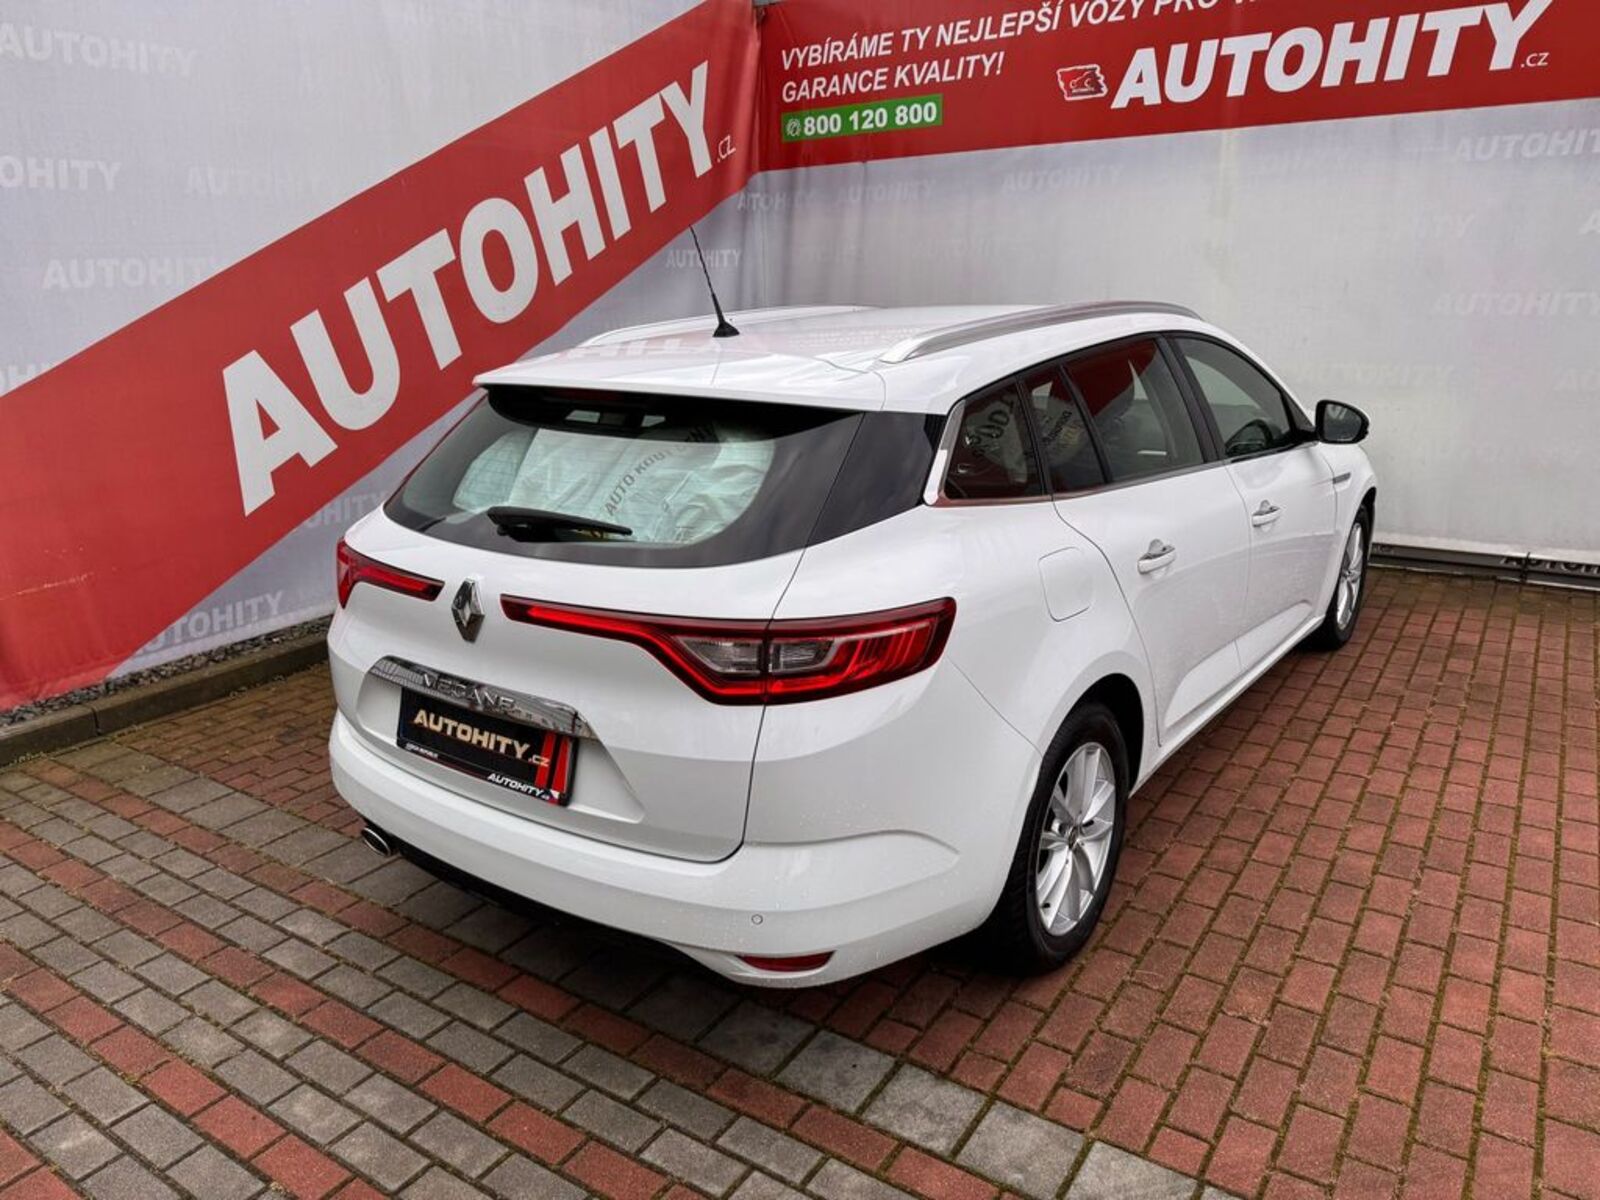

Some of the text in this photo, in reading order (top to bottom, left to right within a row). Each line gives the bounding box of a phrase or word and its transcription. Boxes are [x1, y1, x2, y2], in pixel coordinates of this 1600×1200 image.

[782, 31, 894, 71] VYBÍRÁME
[901, 26, 931, 53] TY
[936, 0, 1063, 48] NEJLEPŠÍ
[1070, 0, 1148, 29] VOZY
[782, 51, 1005, 103] GARANCE KVALITY!
[803, 101, 937, 136] 800 120 800
